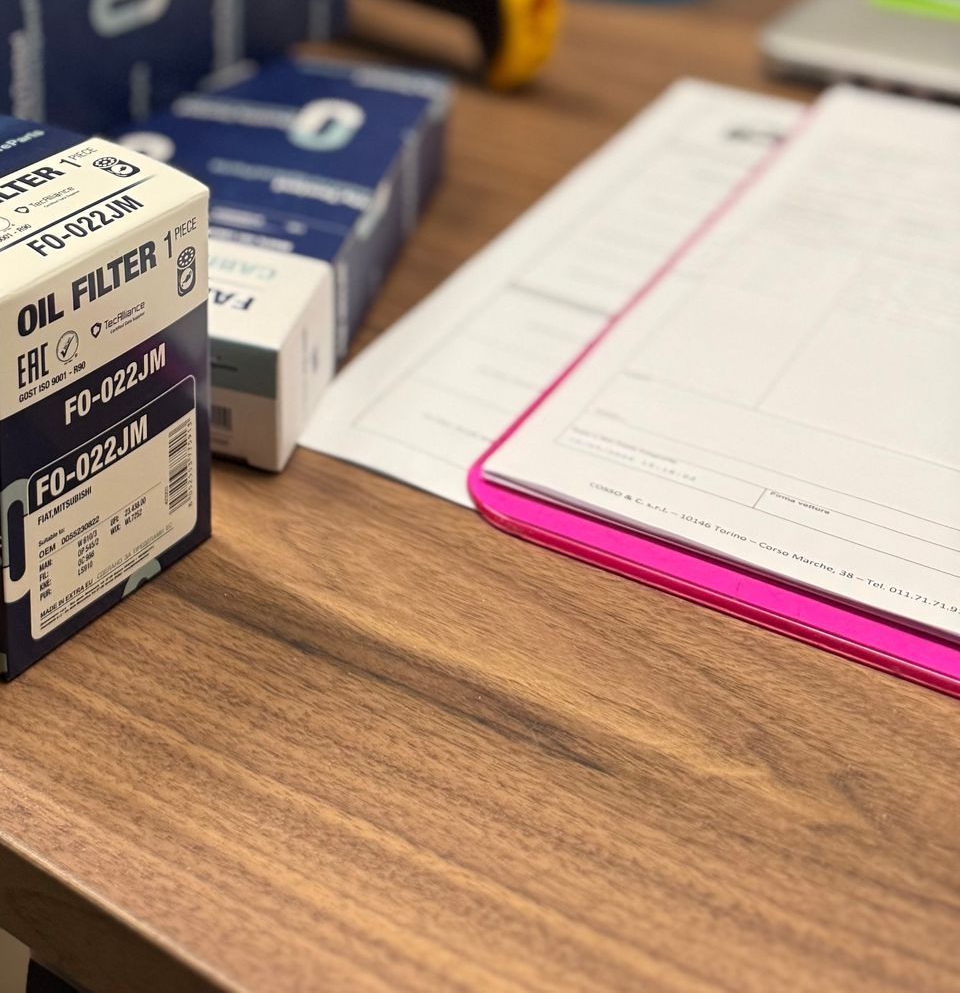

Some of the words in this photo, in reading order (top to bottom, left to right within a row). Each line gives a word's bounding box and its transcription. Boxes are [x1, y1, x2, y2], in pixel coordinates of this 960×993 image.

[59, 158, 82, 168] 1
[68, 146, 98, 161] PIECE
[17, 292, 64, 337] OIL
[71, 240, 157, 311] FILTER
[163, 230, 172, 258] 1
[174, 217, 198, 240] PIECE
[19, 388, 38, 403] GOST
[38, 380, 50, 393] ISO
[51, 371, 67, 386] 9001
[73, 361, 86, 375] R90
[770, 490, 796, 504] Firma
[798, 500, 831, 515] vettore
[38, 543, 56, 559] OEM
[681, 513, 711, 529] 10146
[714, 525, 747, 542] Torino
[758, 541, 789, 557] Corso
[792, 553, 836, 574] Marche,
[838, 569, 854, 579] 38
[867, 578, 886, 591] Tel.
[40, 603, 57, 618] MADE
[64, 585, 85, 604] EXTRA
